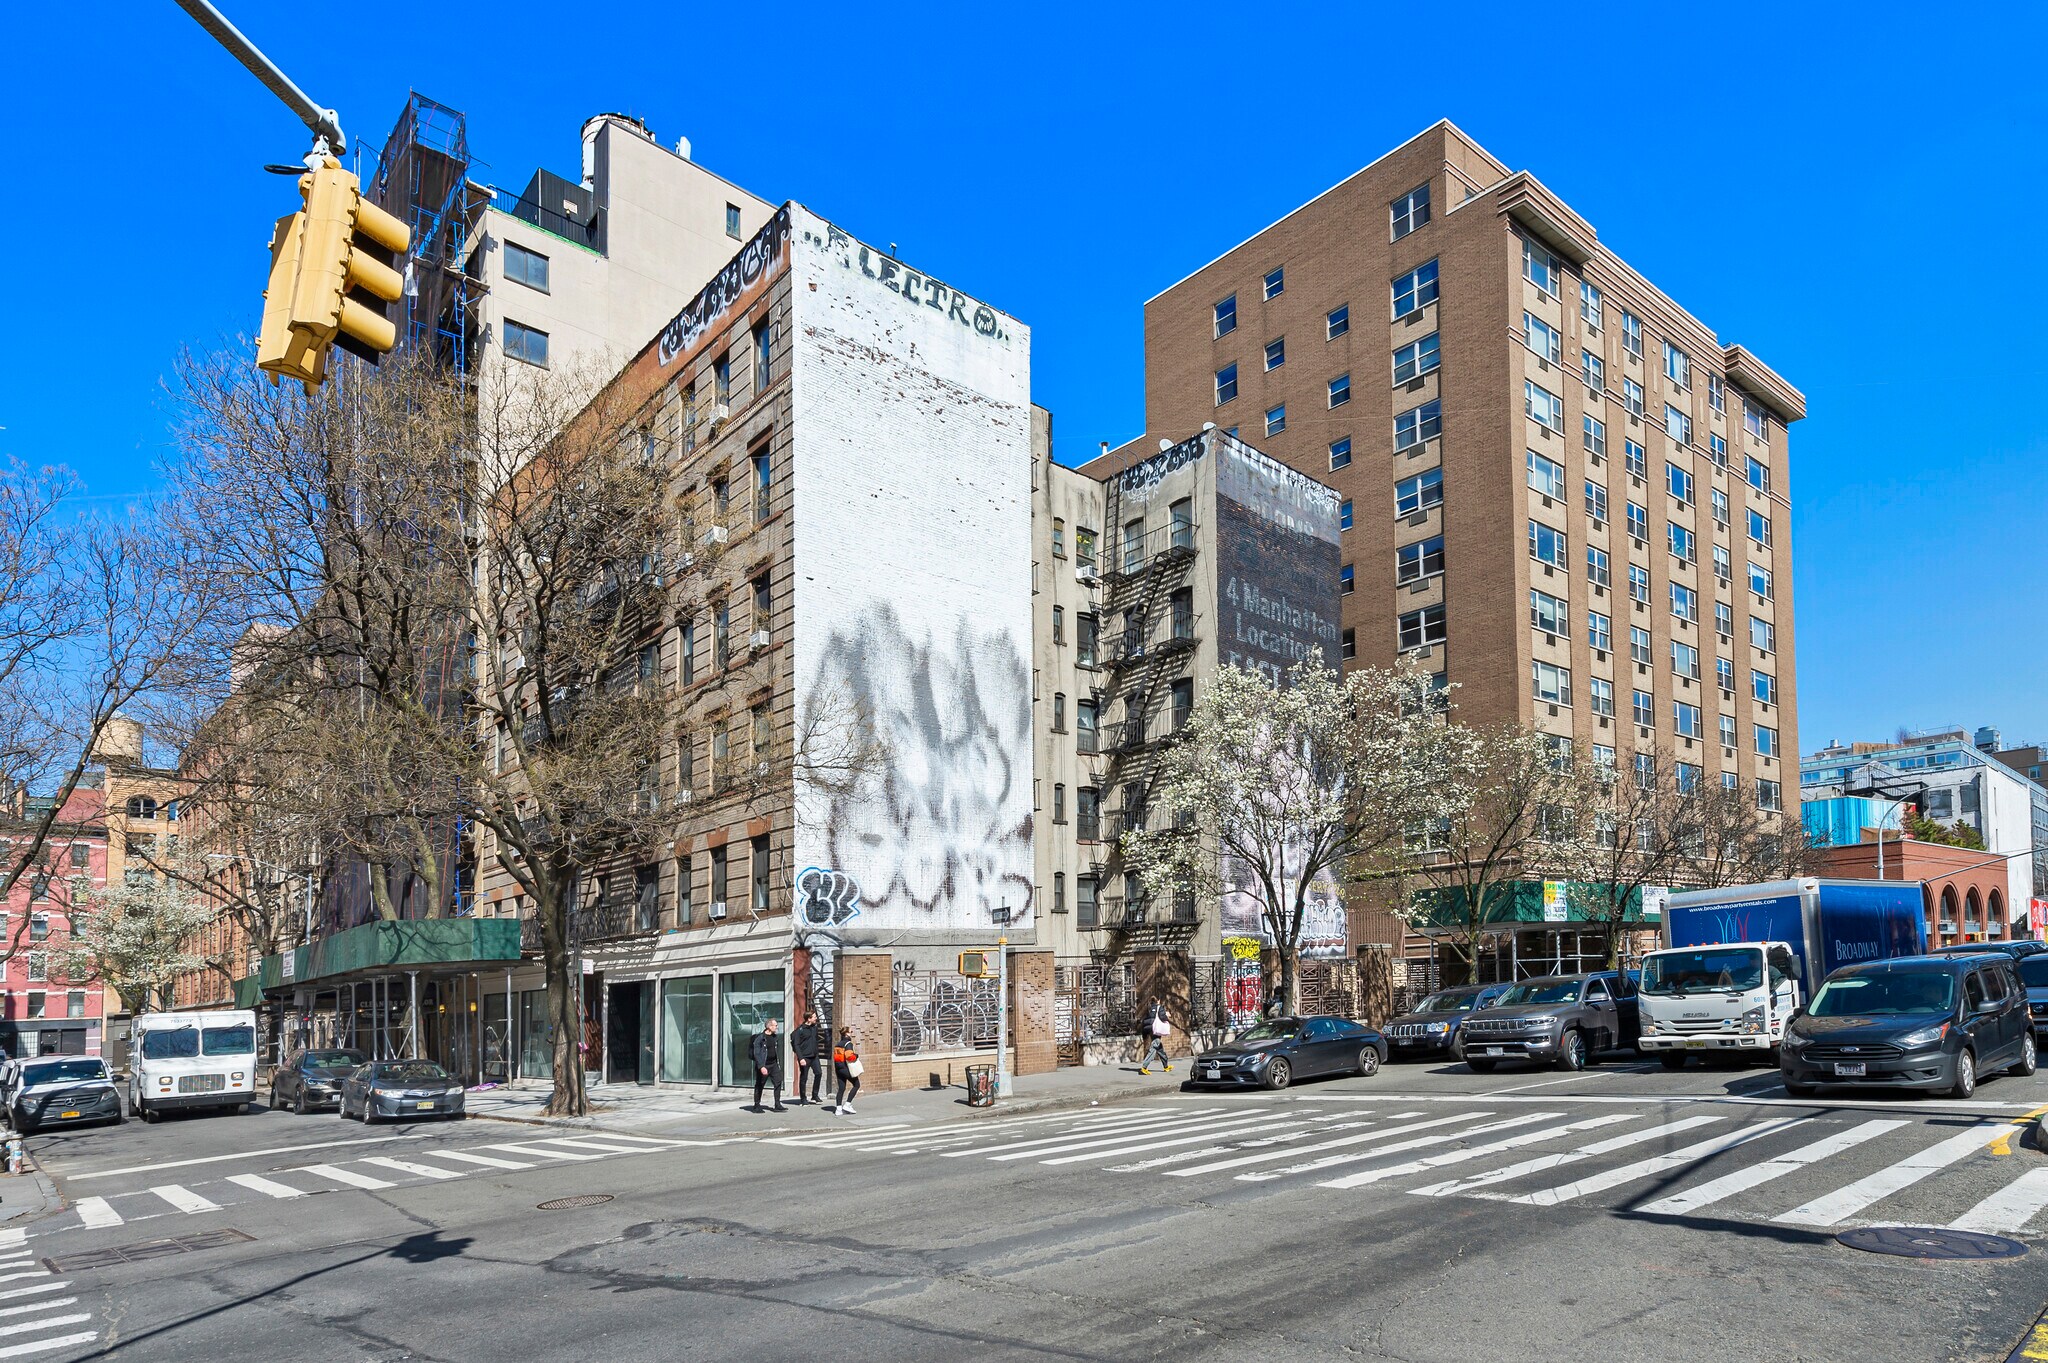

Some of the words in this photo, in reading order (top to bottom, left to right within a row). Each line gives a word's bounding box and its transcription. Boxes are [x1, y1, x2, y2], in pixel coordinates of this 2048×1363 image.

[1226, 576, 1239, 606] 4
[1243, 582, 1336, 641] Manhattan
[1688, 898, 1776, 912] www.broadwaypartyrentals.com
[360, 1000, 398, 1008] CLEANRS
